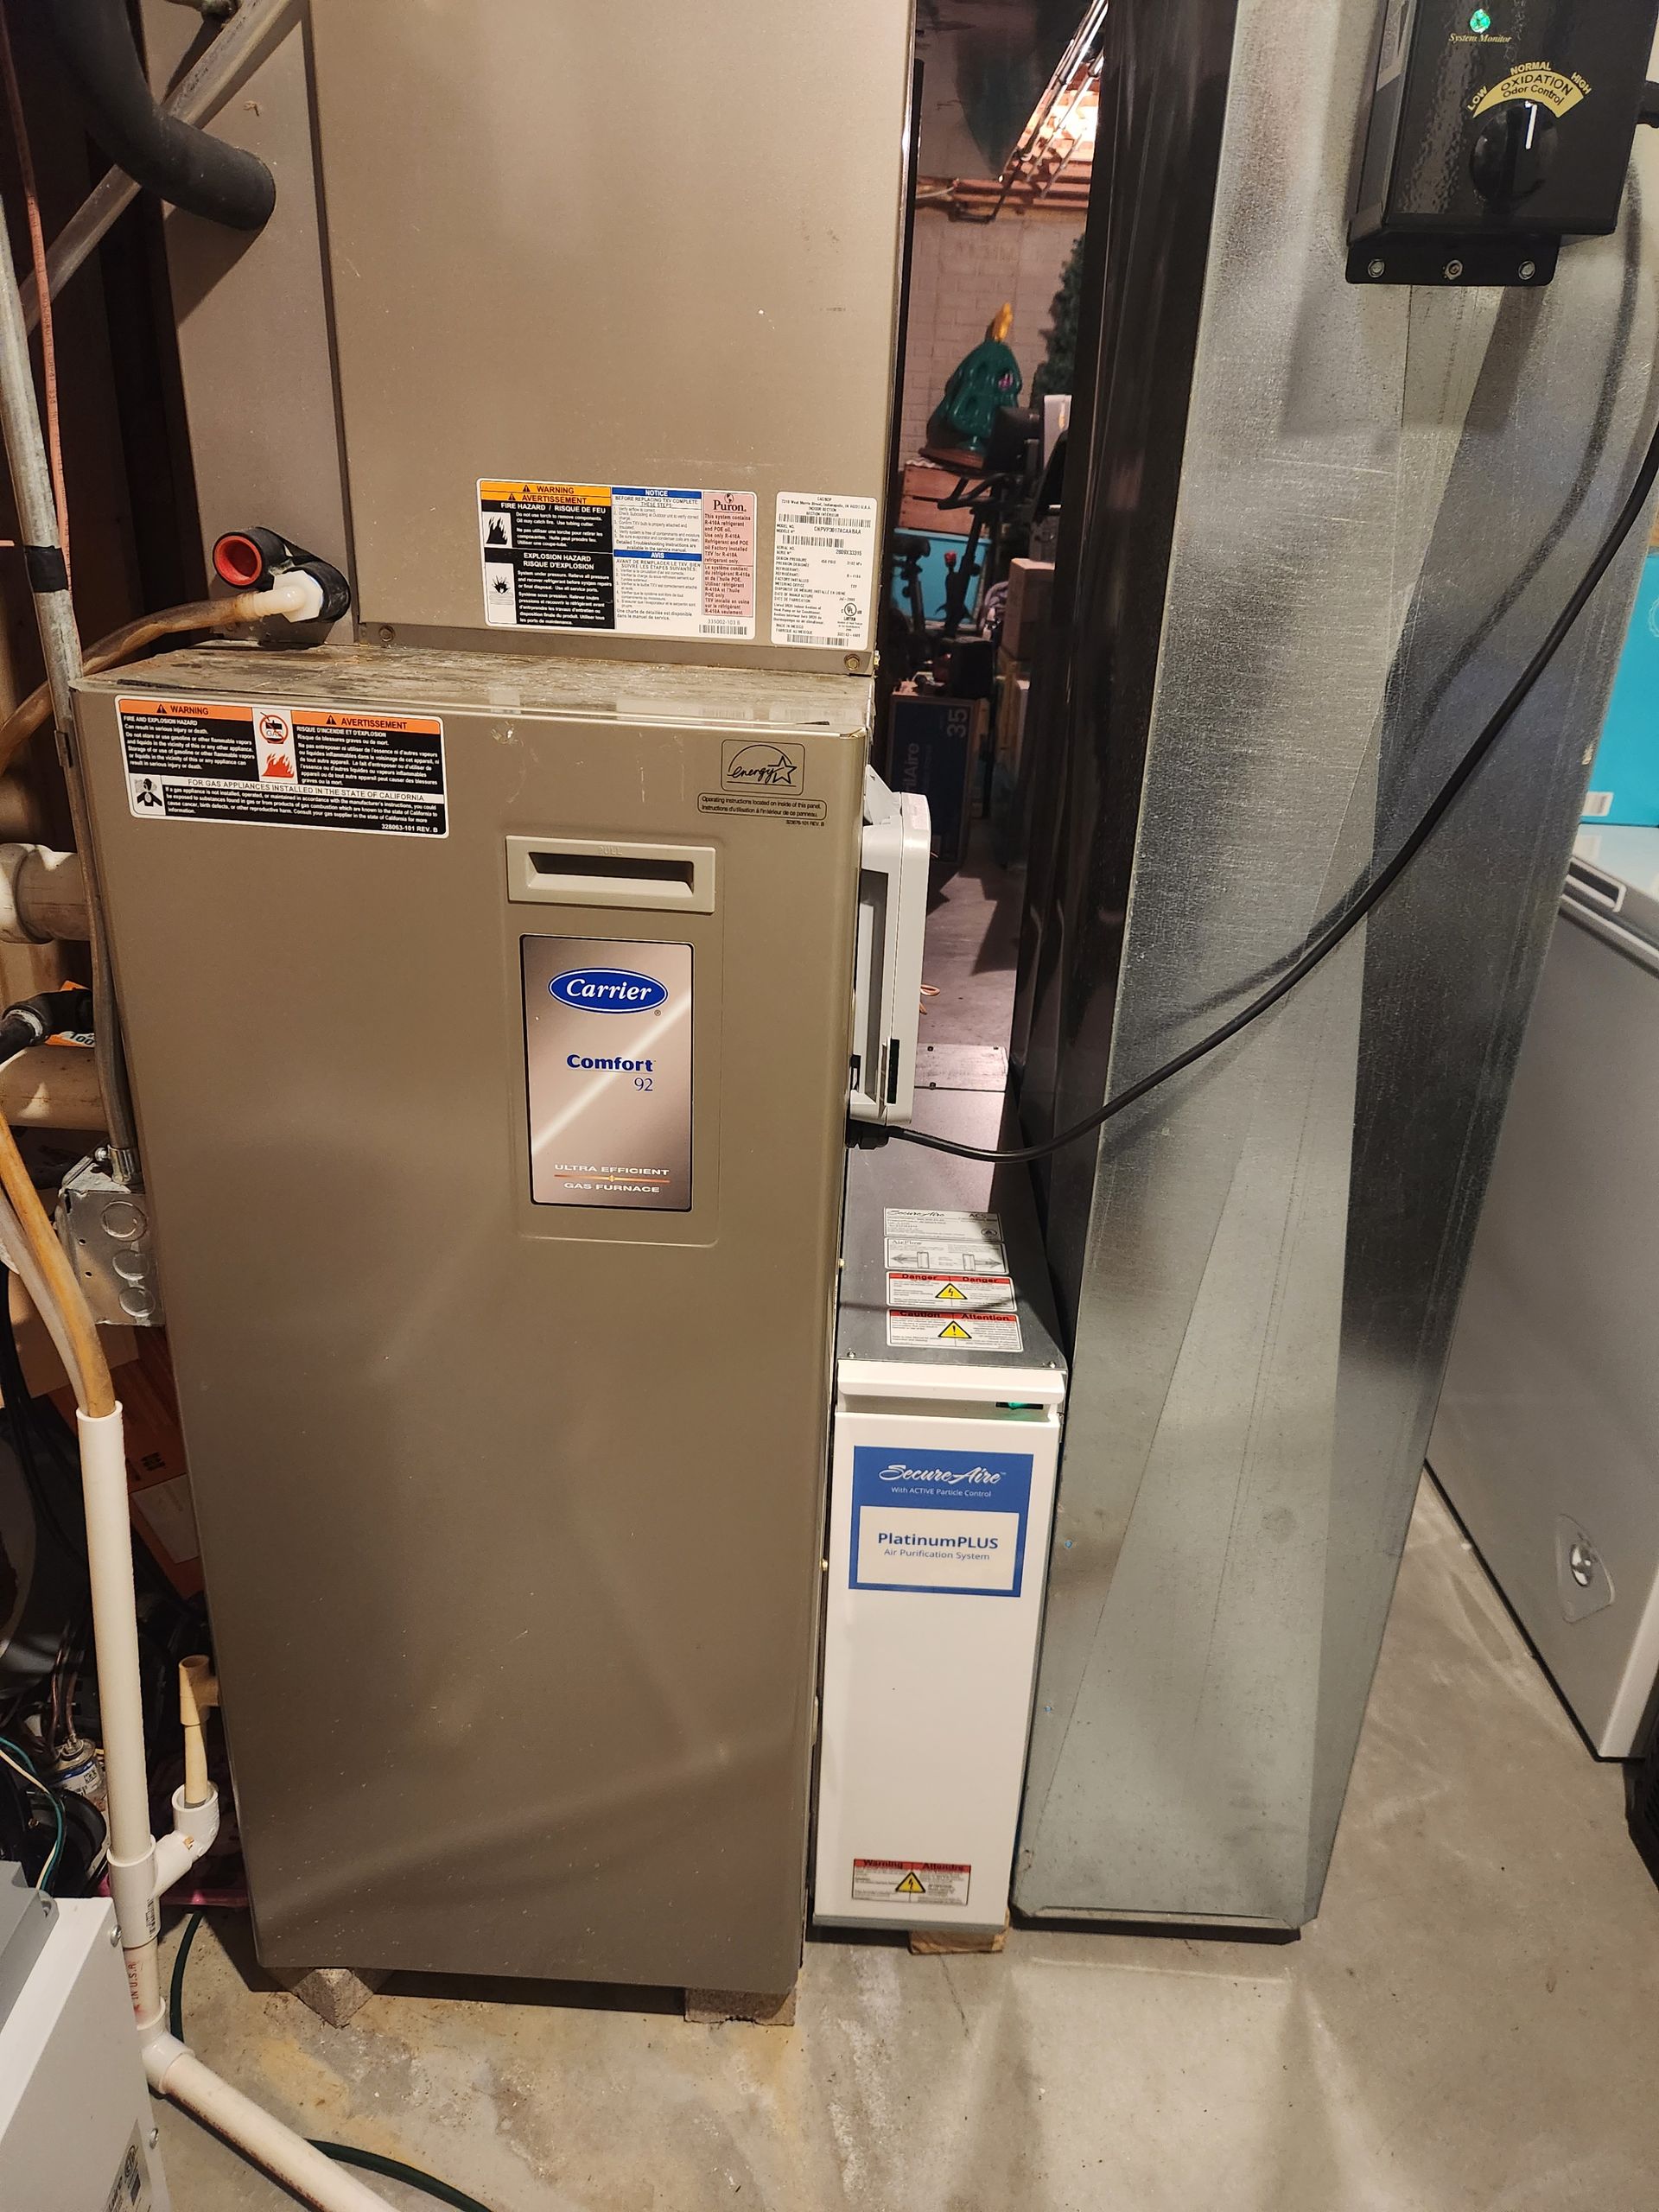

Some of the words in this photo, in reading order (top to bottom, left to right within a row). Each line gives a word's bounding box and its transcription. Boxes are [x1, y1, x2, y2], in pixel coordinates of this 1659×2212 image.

[1448, 33, 1478, 43] System
[1478, 34, 1512, 43] Monitor
[1510, 61, 1552, 75] NORMAL
[1500, 74, 1573, 96] OXIDATION
[1570, 72, 1592, 95] HIGH
[1467, 86, 1489, 111] LOW
[1503, 86, 1528, 98] Odor
[1530, 85, 1565, 105] Control
[536, 486, 574, 494] WARNING
[521, 494, 587, 504] AVERTISSEMENT
[713, 500, 743, 512] Puron
[169, 705, 208, 715] WARNING
[340, 717, 407, 729] AVERTISSEMENT
[947, 709, 967, 738] 35
[728, 766, 777, 784] energy
[223, 781, 270, 790] APPLIANCES
[271, 785, 313, 793] INSTALLED
[378, 791, 424, 801] CALIFORNIA
[566, 979, 652, 1001] Carrier
[567, 1054, 653, 1072] Comfort
[634, 1077, 653, 1092] 92
[555, 1164, 597, 1173] ULTRA
[601, 1166, 670, 1176] EFFICIENT
[563, 1182, 592, 1191] GAS
[596, 1184, 660, 1193] FURNACE
[936, 1488, 963, 1497] Particle
[964, 1490, 992, 1498] Control
[878, 1532, 999, 1549] PlatinumPLUS
[899, 1549, 954, 1559] Purification
[956, 1551, 990, 1561] System
[863, 1859, 904, 1869] Warning
[130, 1991, 139, 1999] IN
